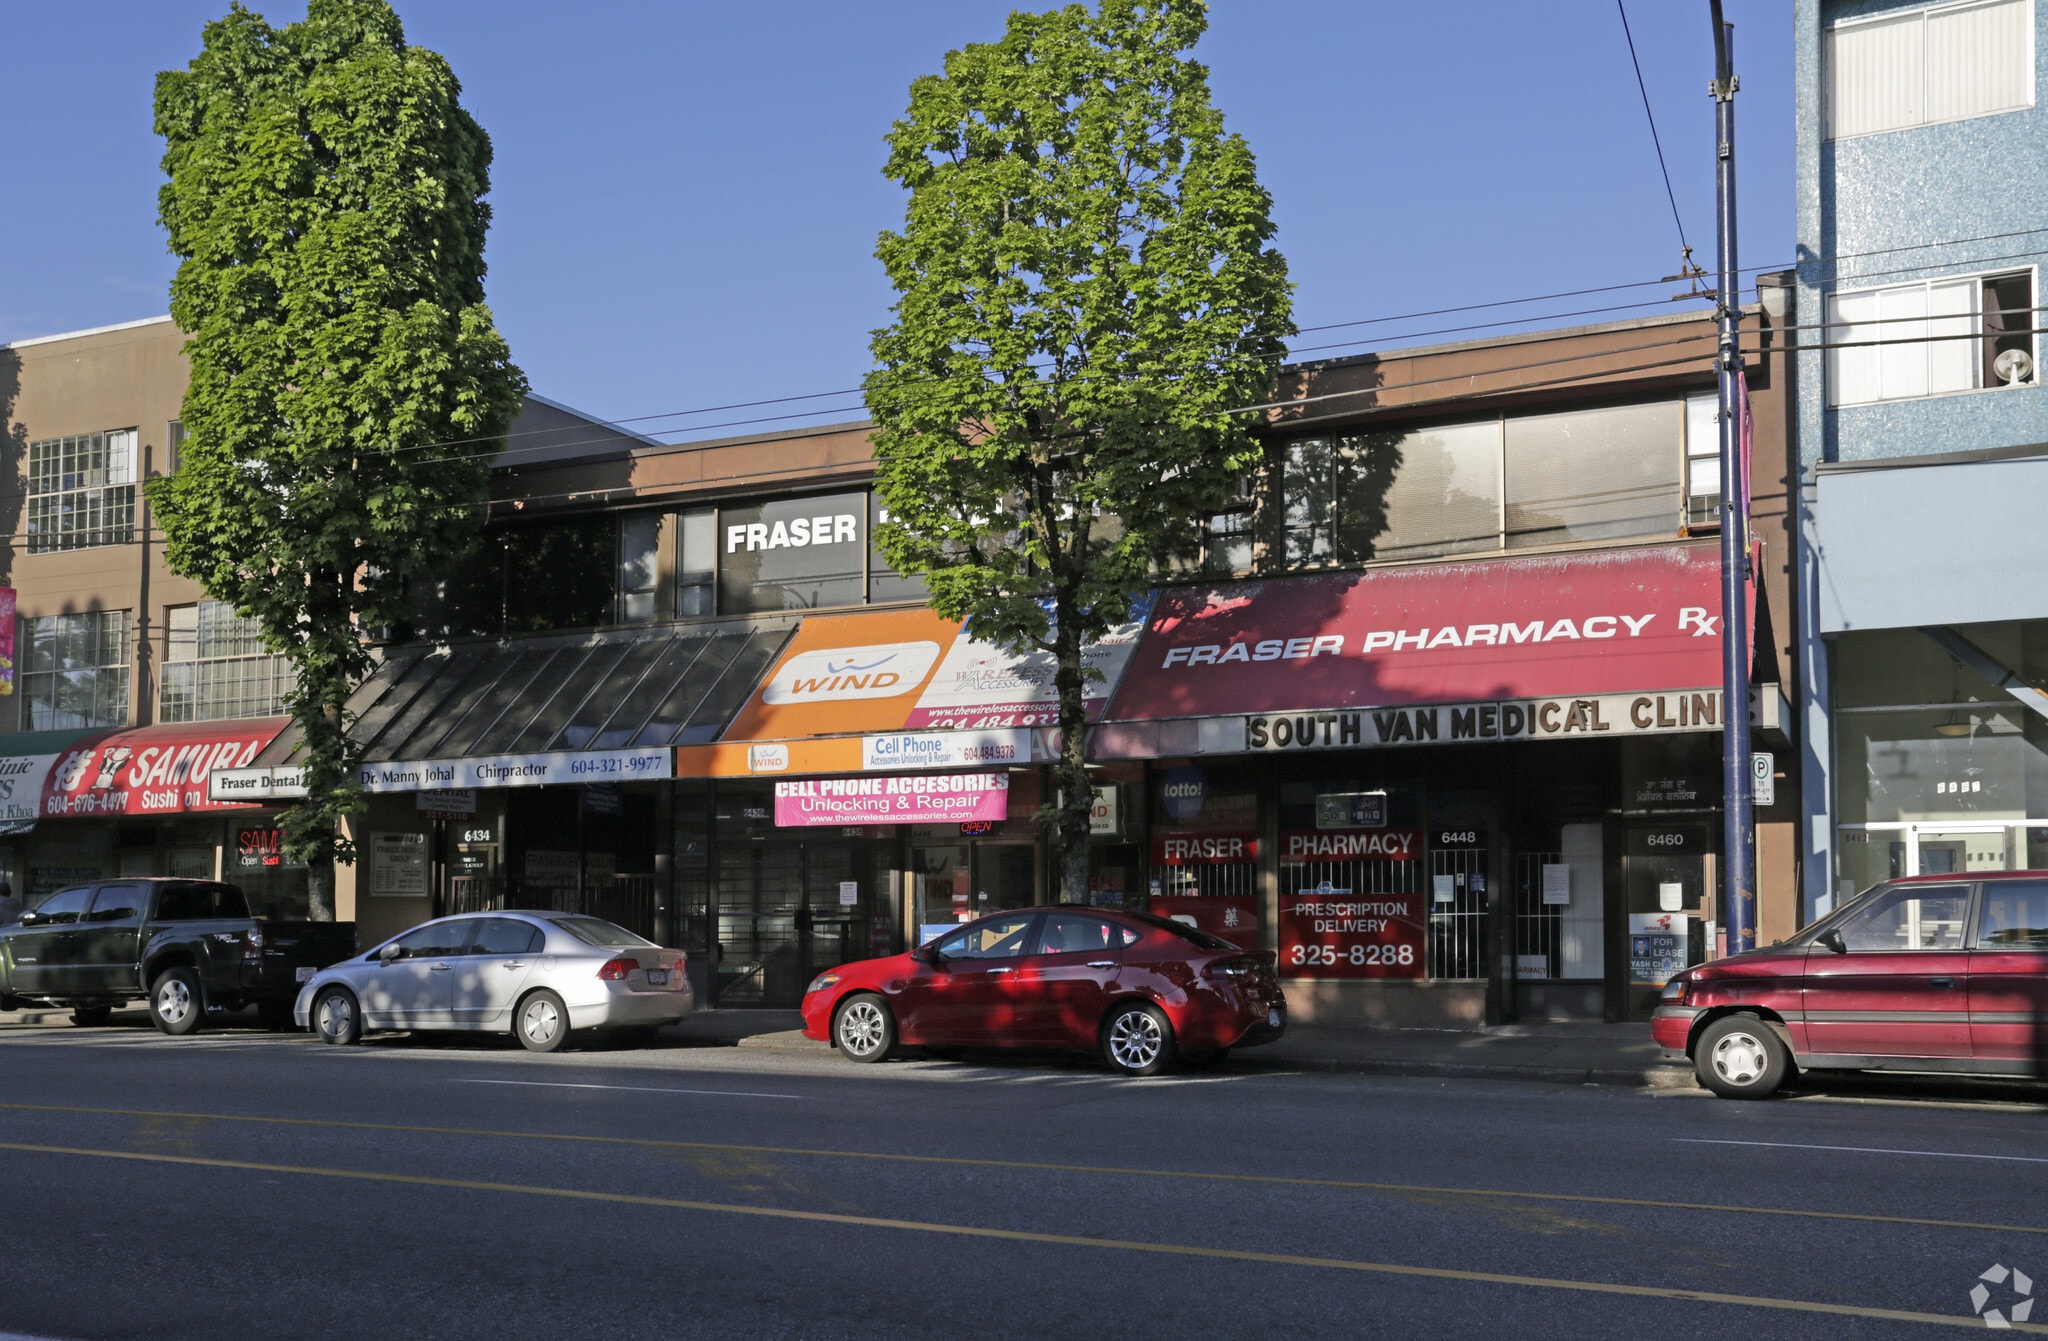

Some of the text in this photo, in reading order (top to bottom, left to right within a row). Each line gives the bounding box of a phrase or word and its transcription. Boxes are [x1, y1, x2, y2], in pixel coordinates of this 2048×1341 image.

[727, 513, 857, 554] FRASER
[1162, 634, 1345, 670] FRASER
[1361, 613, 1656, 654] PHARMACY
[791, 672, 900, 695] WIND
[954, 670, 1047, 692] ACCESSORIES
[1249, 693, 1756, 750] SOUTH VAN MEDICAL CLIN
[875, 737, 942, 756] Cell Phone
[963, 744, 1015, 761] 604.484.9378
[129, 739, 272, 788] SAMURA
[754, 758, 783, 767] WIND
[871, 752, 952, 766] Accessories Unlocking & Repair
[361, 756, 663, 786] Dr. Manny Johal Chirpractor 604-321-9977
[221, 775, 300, 789] Fraser Dental
[775, 772, 1009, 798] CELL PHONE ACCESORIES
[1163, 783, 1203, 797] lotto!
[47, 791, 129, 814] 604-676-4479
[141, 789, 179, 809] Sushi
[184, 791, 201, 807] on
[801, 793, 980, 813] Unlocking & Repair
[7, 804, 34, 819] Khoa
[809, 811, 973, 823] www.thewirelessaccessories.com
[464, 829, 491, 842] 6434
[961, 821, 993, 833] OPEN
[1289, 833, 1413, 855] PHARMACY
[1441, 832, 1476, 843] 6448
[1647, 834, 1684, 846] 6460
[1165, 838, 1243, 860] FRASER
[1295, 902, 1408, 916] PRESCRIPTION
[1314, 919, 1388, 932] DELIVERY
[1653, 938, 1673, 946] FOR
[1291, 944, 1414, 965] 325-8288
[1653, 949, 1684, 957] LEASE
